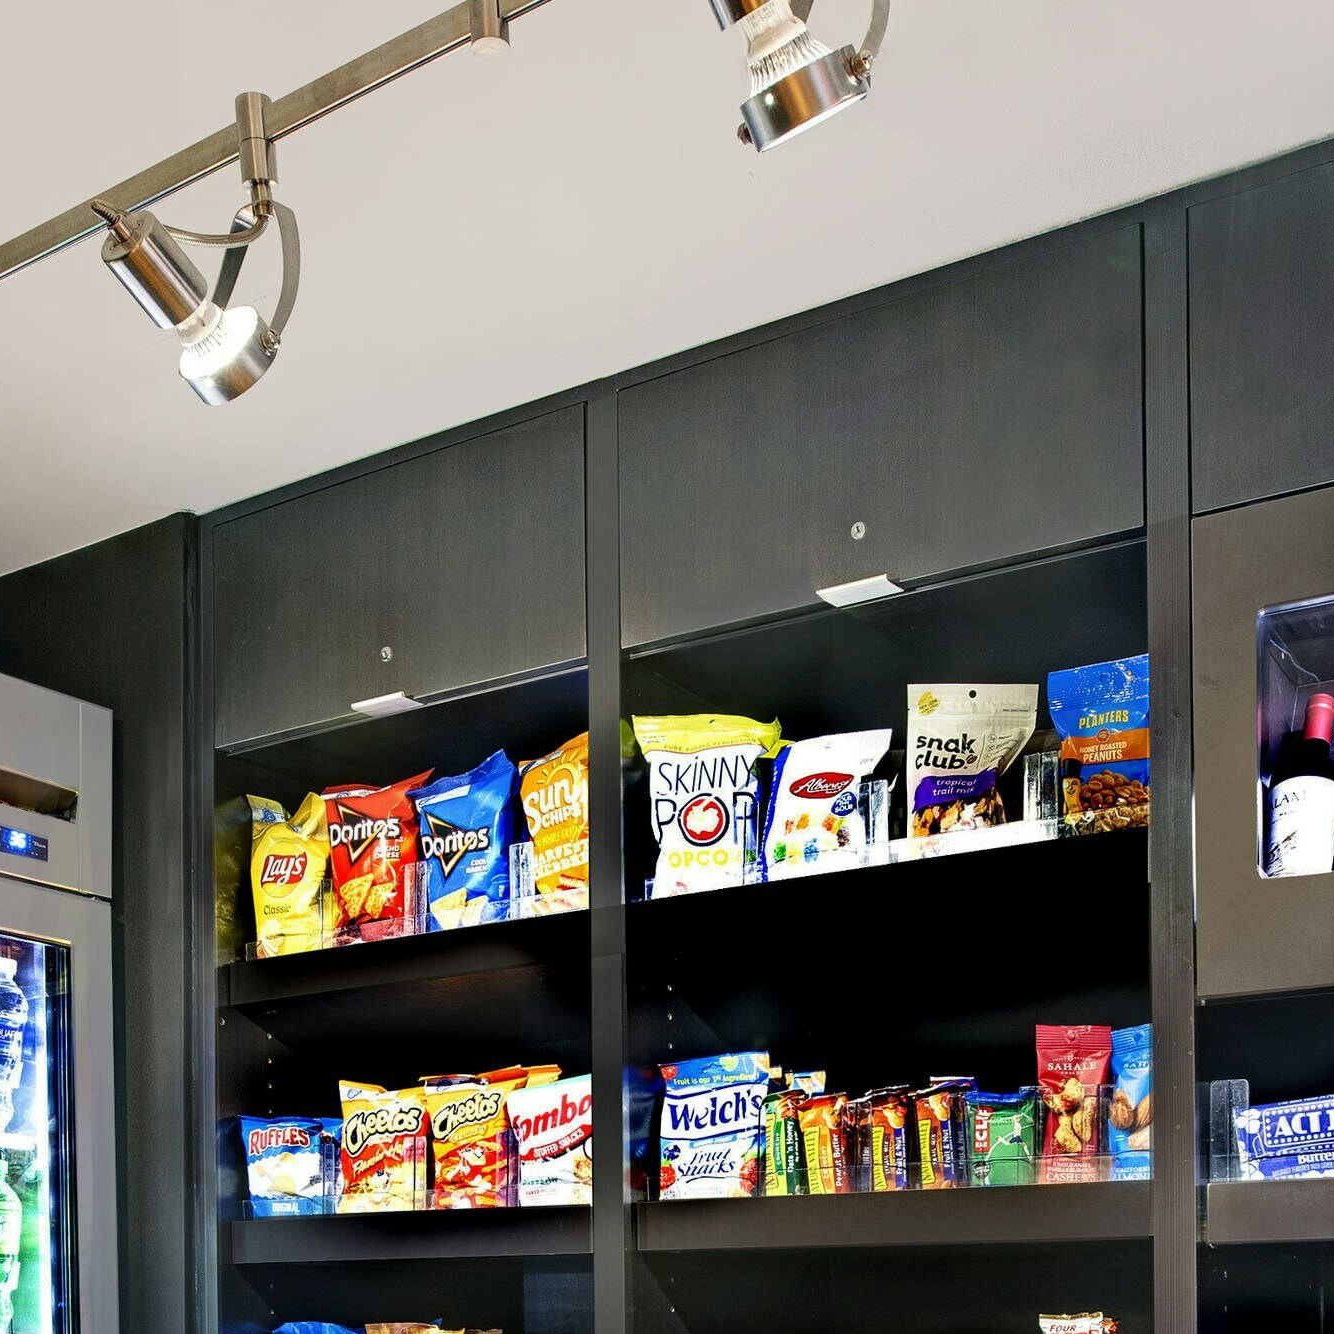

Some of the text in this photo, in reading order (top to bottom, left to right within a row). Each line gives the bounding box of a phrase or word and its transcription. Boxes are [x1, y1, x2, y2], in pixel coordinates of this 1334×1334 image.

[1079, 710, 1129, 729] PLANTERS
[916, 733, 977, 754] snak
[1079, 741, 1127, 753] HONEY ROASTED
[1083, 750, 1123, 763] PEANUTS
[933, 785, 974, 797] trail mix
[936, 778, 977, 788] tropical
[329, 817, 401, 847] Doritos
[421, 826, 489, 859] Doritos
[263, 852, 307, 885] Lay's
[263, 903, 291, 916] Classic
[1047, 1061, 1097, 1071] SAHALE
[691, 1077, 697, 1085] is
[433, 1092, 502, 1139] Cheetos
[668, 1089, 764, 1132] Welch's
[345, 1107, 422, 1157] Cheetos
[786, 1120, 795, 1144] Honey
[974, 1110, 991, 1141] CLIF
[1273, 1110, 1323, 1138] ACT
[249, 1127, 310, 1156] RUFFLES
[830, 1132, 839, 1157] Butter
[942, 1128, 951, 1144] Nut
[1046, 1172, 1097, 1182] CASHEWS
[1049, 1324, 1078, 1333] FOUR
